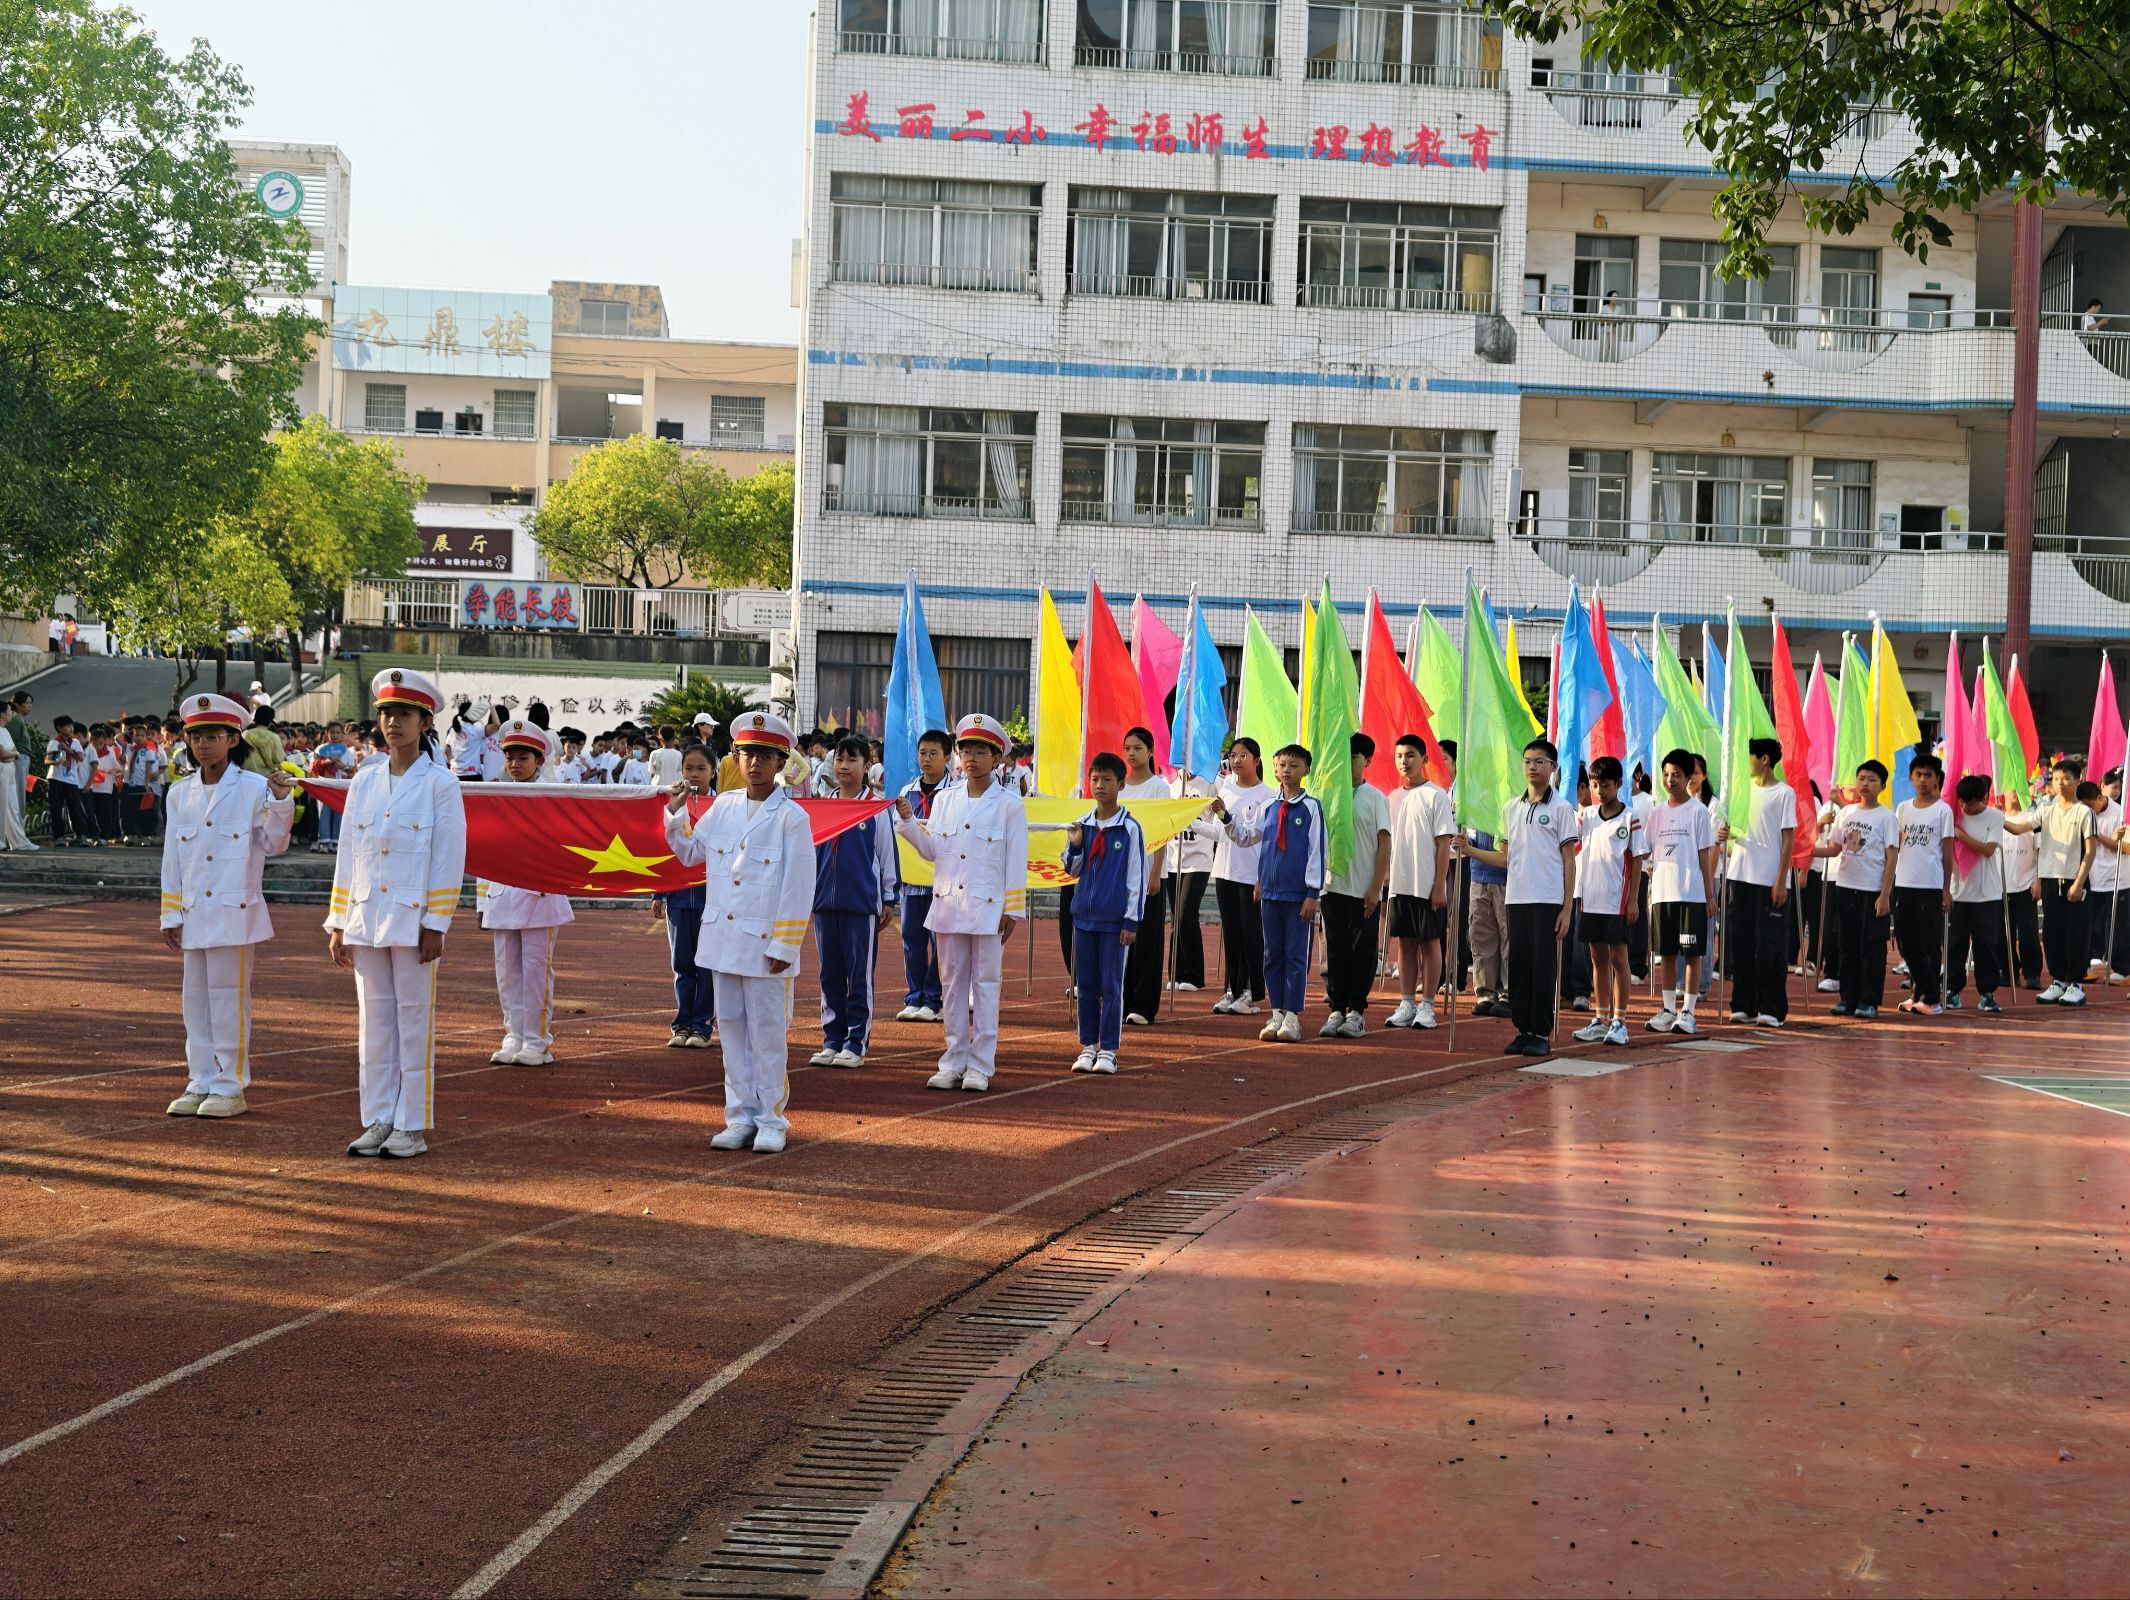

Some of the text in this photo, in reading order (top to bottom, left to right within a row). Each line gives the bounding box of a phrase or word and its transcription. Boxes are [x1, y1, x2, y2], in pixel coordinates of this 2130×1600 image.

[838, 90, 1498, 172] 美丽二小 幸福师生 理想教育
[355, 306, 537, 359] 九鼎楼
[431, 533, 489, 554] 展厅
